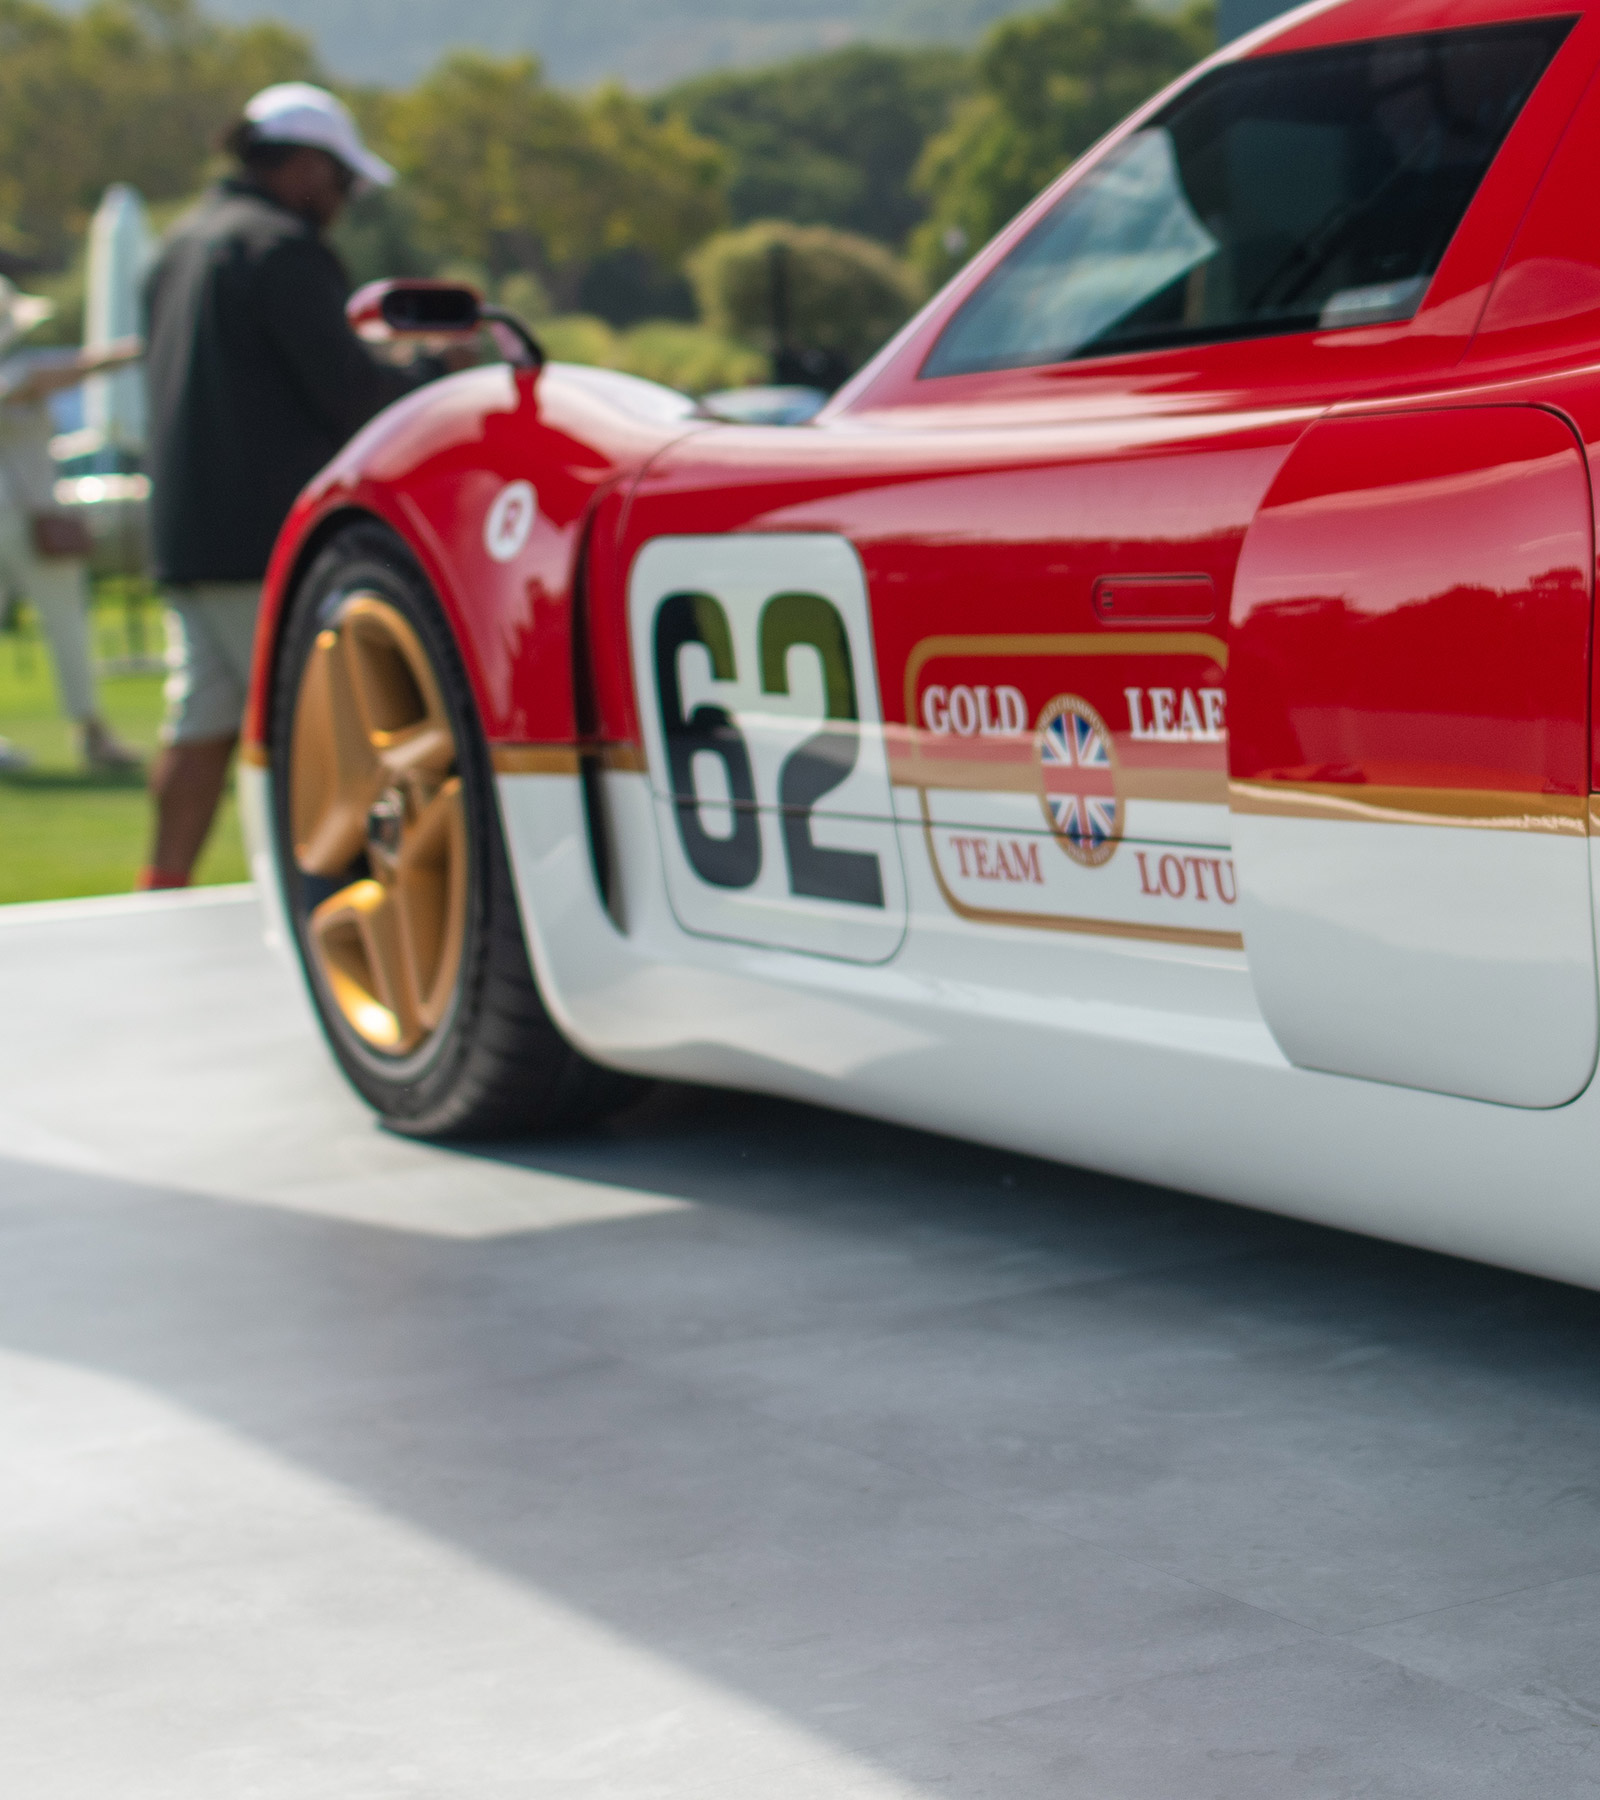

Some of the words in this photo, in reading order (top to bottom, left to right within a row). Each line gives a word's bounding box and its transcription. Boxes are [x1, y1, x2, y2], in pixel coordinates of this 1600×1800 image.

[922, 684, 1029, 736] GOLD
[1123, 687, 1227, 742] LEAF
[652, 589, 886, 909] 62
[949, 836, 1044, 884] TEAM
